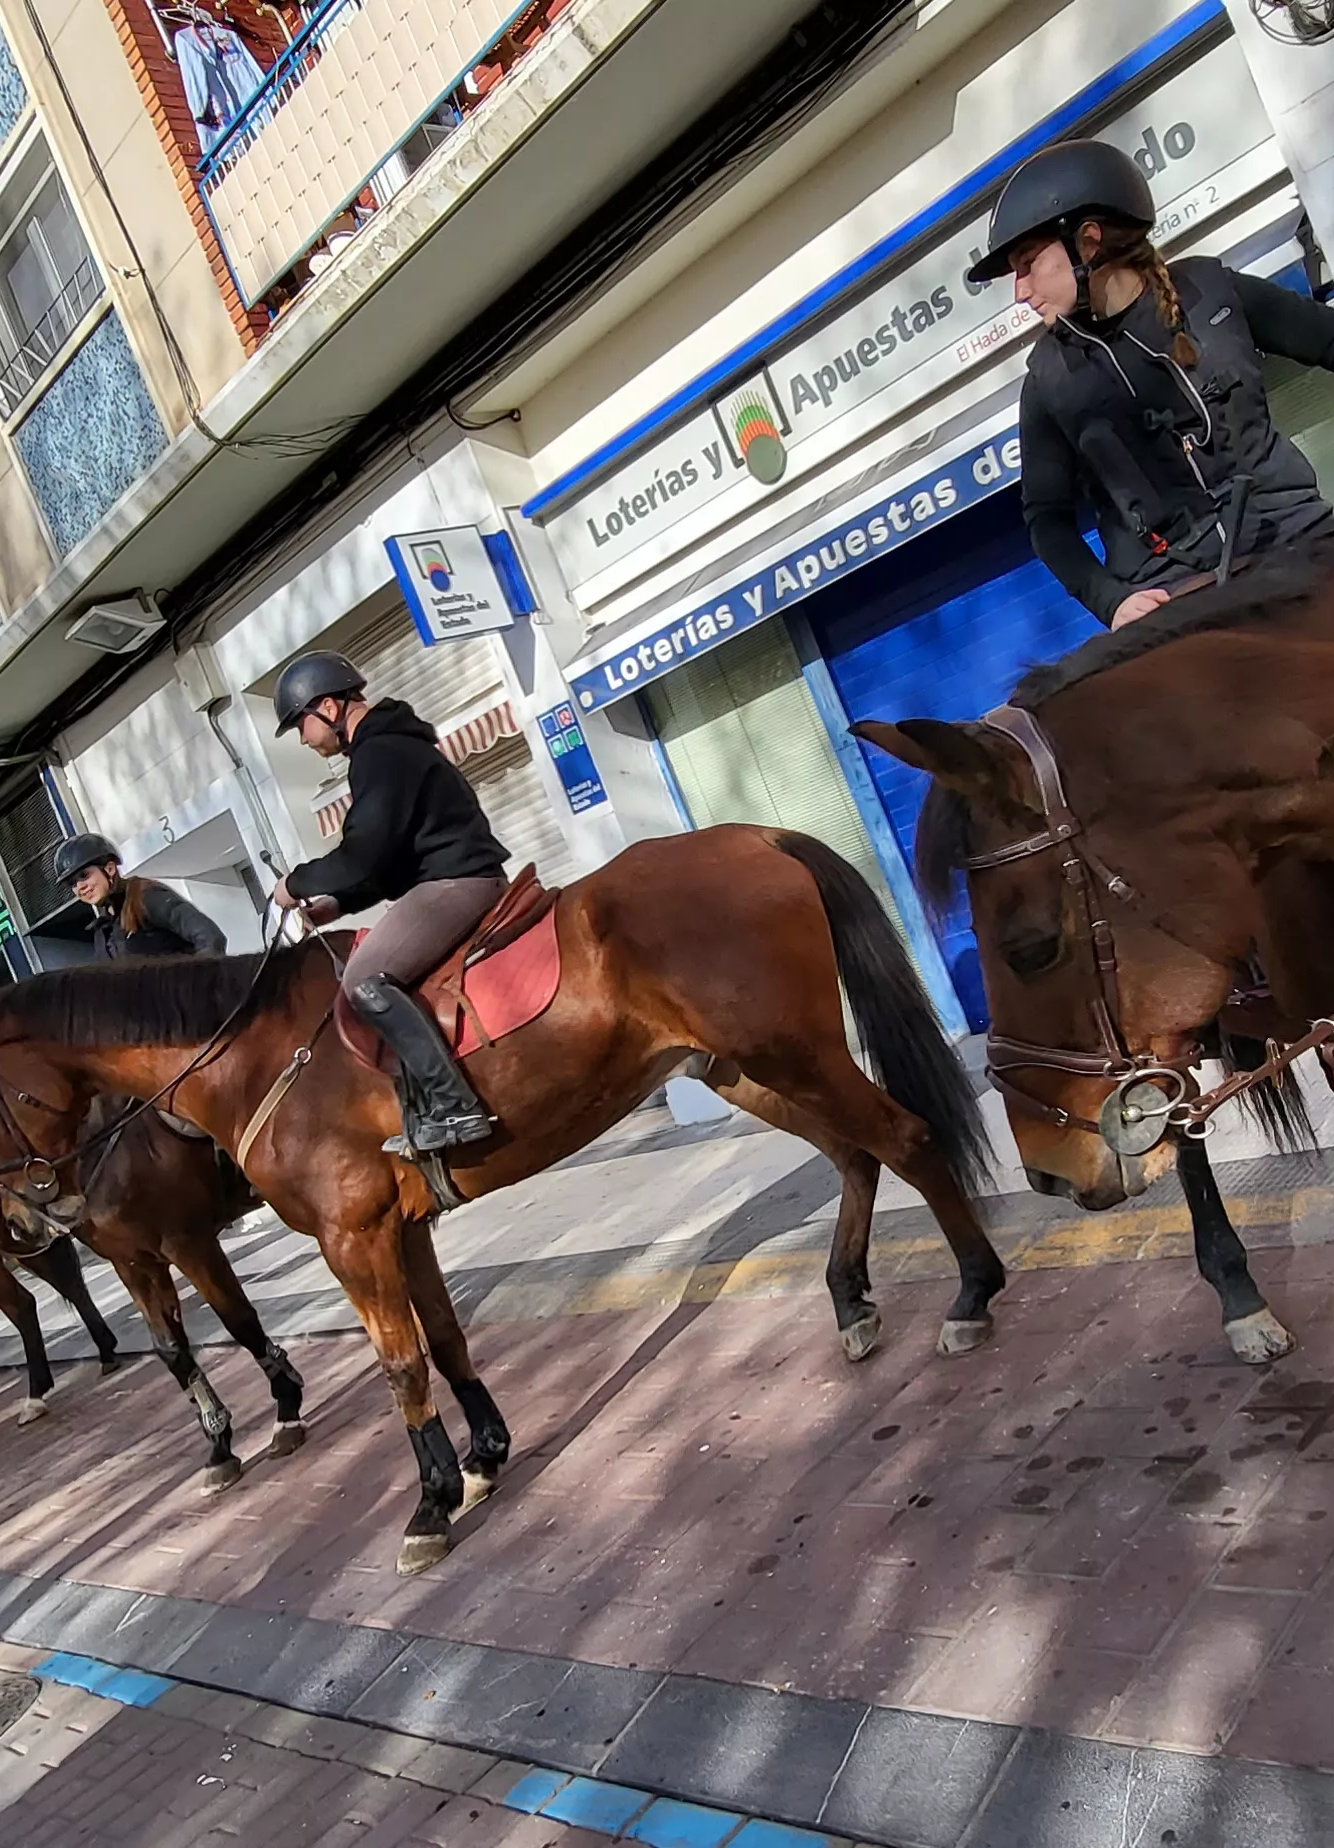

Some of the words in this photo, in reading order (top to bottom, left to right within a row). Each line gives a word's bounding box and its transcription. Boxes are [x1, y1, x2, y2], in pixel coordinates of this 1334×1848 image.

[956, 345, 970, 363] El
[970, 323, 1008, 351] Hada
[1011, 308, 1031, 328] de
[1205, 186, 1220, 203] 2
[586, 458, 699, 548] Loterías
[701, 440, 723, 480] y
[789, 286, 954, 416] Apuestas
[604, 603, 734, 691] Loterías
[742, 584, 764, 617] y
[773, 477, 957, 597] Apuestas
[972, 438, 1022, 486] de
[158, 815, 175, 844] 3
